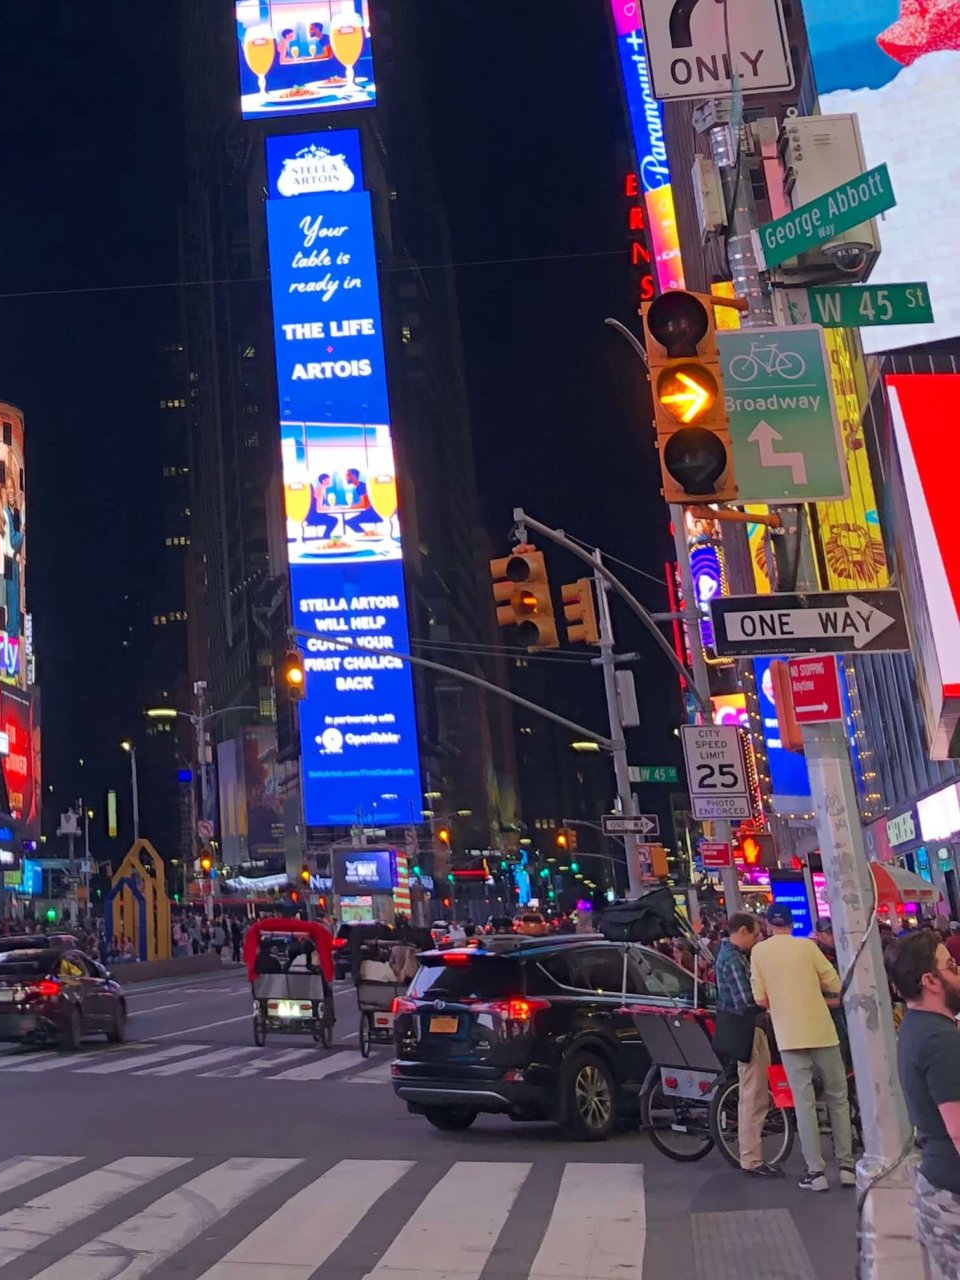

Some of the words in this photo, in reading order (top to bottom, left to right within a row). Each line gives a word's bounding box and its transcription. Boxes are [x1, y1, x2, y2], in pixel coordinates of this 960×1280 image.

[670, 49, 764, 85] ONLY
[292, 164, 338, 175] STELLA
[294, 175, 340, 185] ARTOIS
[765, 208, 821, 250] George
[828, 171, 884, 219] Abbott
[299, 215, 348, 248] Your
[817, 222, 835, 238] Way
[292, 248, 331, 269] table
[336, 252, 350, 265] is
[289, 273, 338, 302] ready
[343, 275, 361, 289] in
[815, 293, 840, 323] W
[859, 290, 894, 321] 45
[905, 287, 925, 308] St
[282, 322, 324, 340] THE
[330, 318, 375, 338] LIFE
[292, 358, 372, 380] ARTOIS
[725, 393, 821, 412] Broadway
[300, 597, 348, 612] STELLA
[350, 595, 399, 610] ARTOIS
[315, 618, 349, 632] WILL
[351, 616, 386, 630] HELP
[741, 613, 794, 637] ONE
[818, 610, 874, 634] WAY
[304, 657, 341, 672] FIRST
[343, 655, 404, 670] CHALICE
[790, 665, 799, 677] NO
[799, 662, 825, 677] STOPPING
[336, 676, 374, 691] BACK
[793, 680, 815, 694] Anytime
[698, 729, 721, 738] CITY
[695, 740, 728, 749] SPEED
[700, 751, 725, 760] LIMIT
[641, 770, 650, 779] W
[654, 769, 665, 780] 45
[696, 763, 738, 788] 25
[706, 799, 735, 807] PHOTO
[610, 821, 625, 829] ONE
[634, 821, 649, 829] WAY
